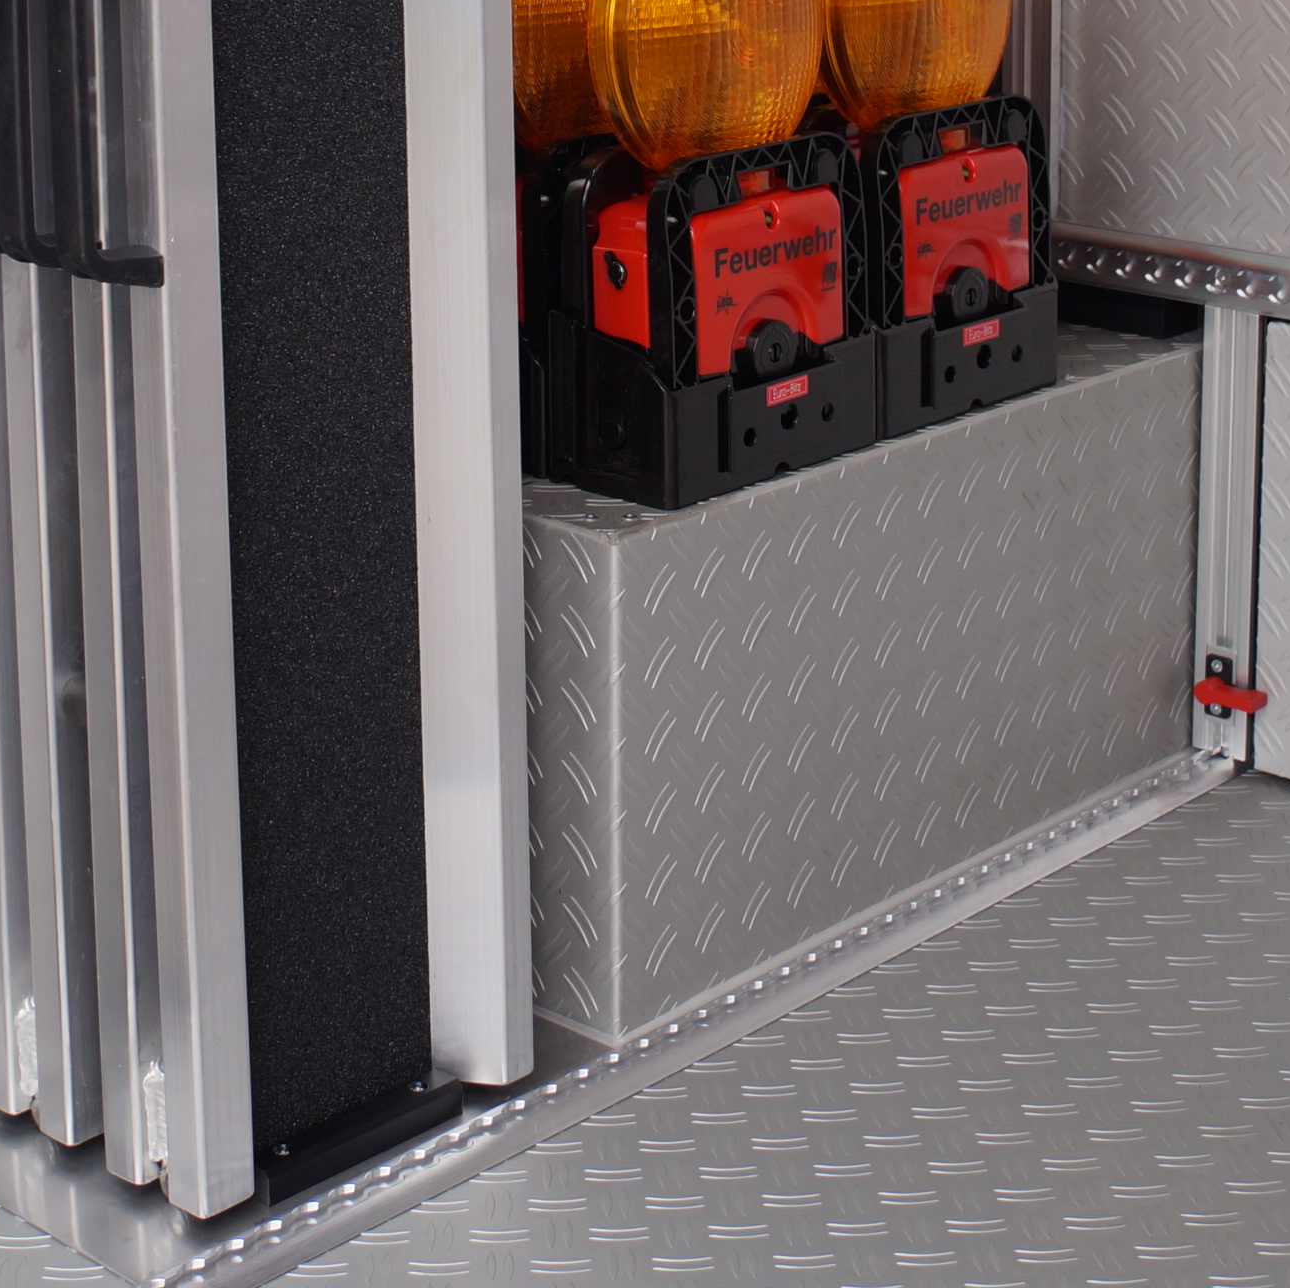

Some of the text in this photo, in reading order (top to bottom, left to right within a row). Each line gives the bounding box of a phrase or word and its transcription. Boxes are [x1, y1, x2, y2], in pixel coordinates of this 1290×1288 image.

[915, 179, 1022, 226] Feuerwehr
[713, 225, 837, 278] Feuerwehr
[772, 383, 801, 399] Euro-Blitz
